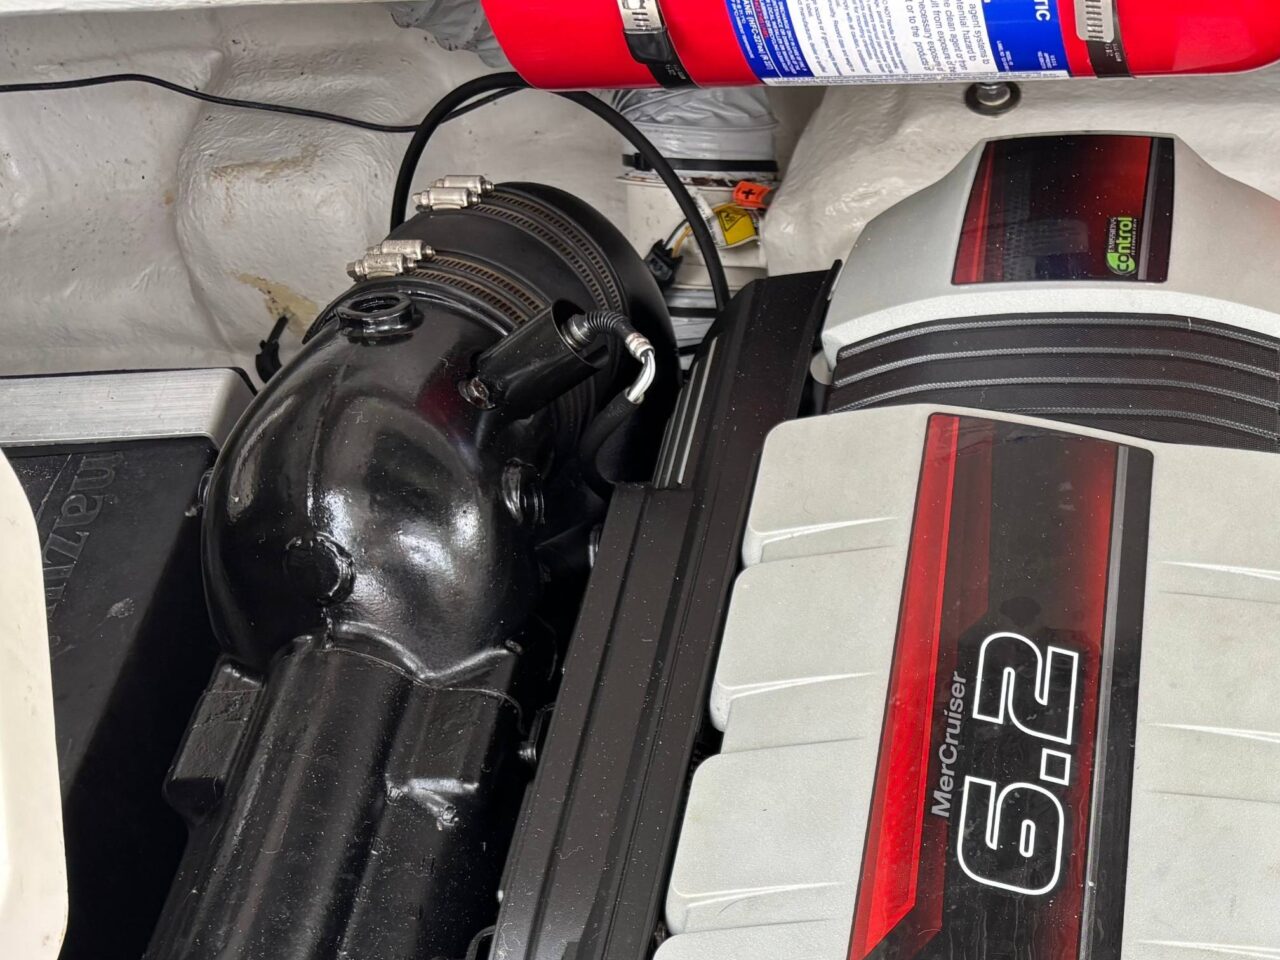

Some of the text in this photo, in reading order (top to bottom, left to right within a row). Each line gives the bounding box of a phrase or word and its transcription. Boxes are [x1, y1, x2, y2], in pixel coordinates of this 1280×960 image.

[968, 4, 980, 28] agent
[1116, 217, 1133, 272] control
[931, 670, 967, 818] MerCruiser
[957, 631, 1078, 896] 6.2
